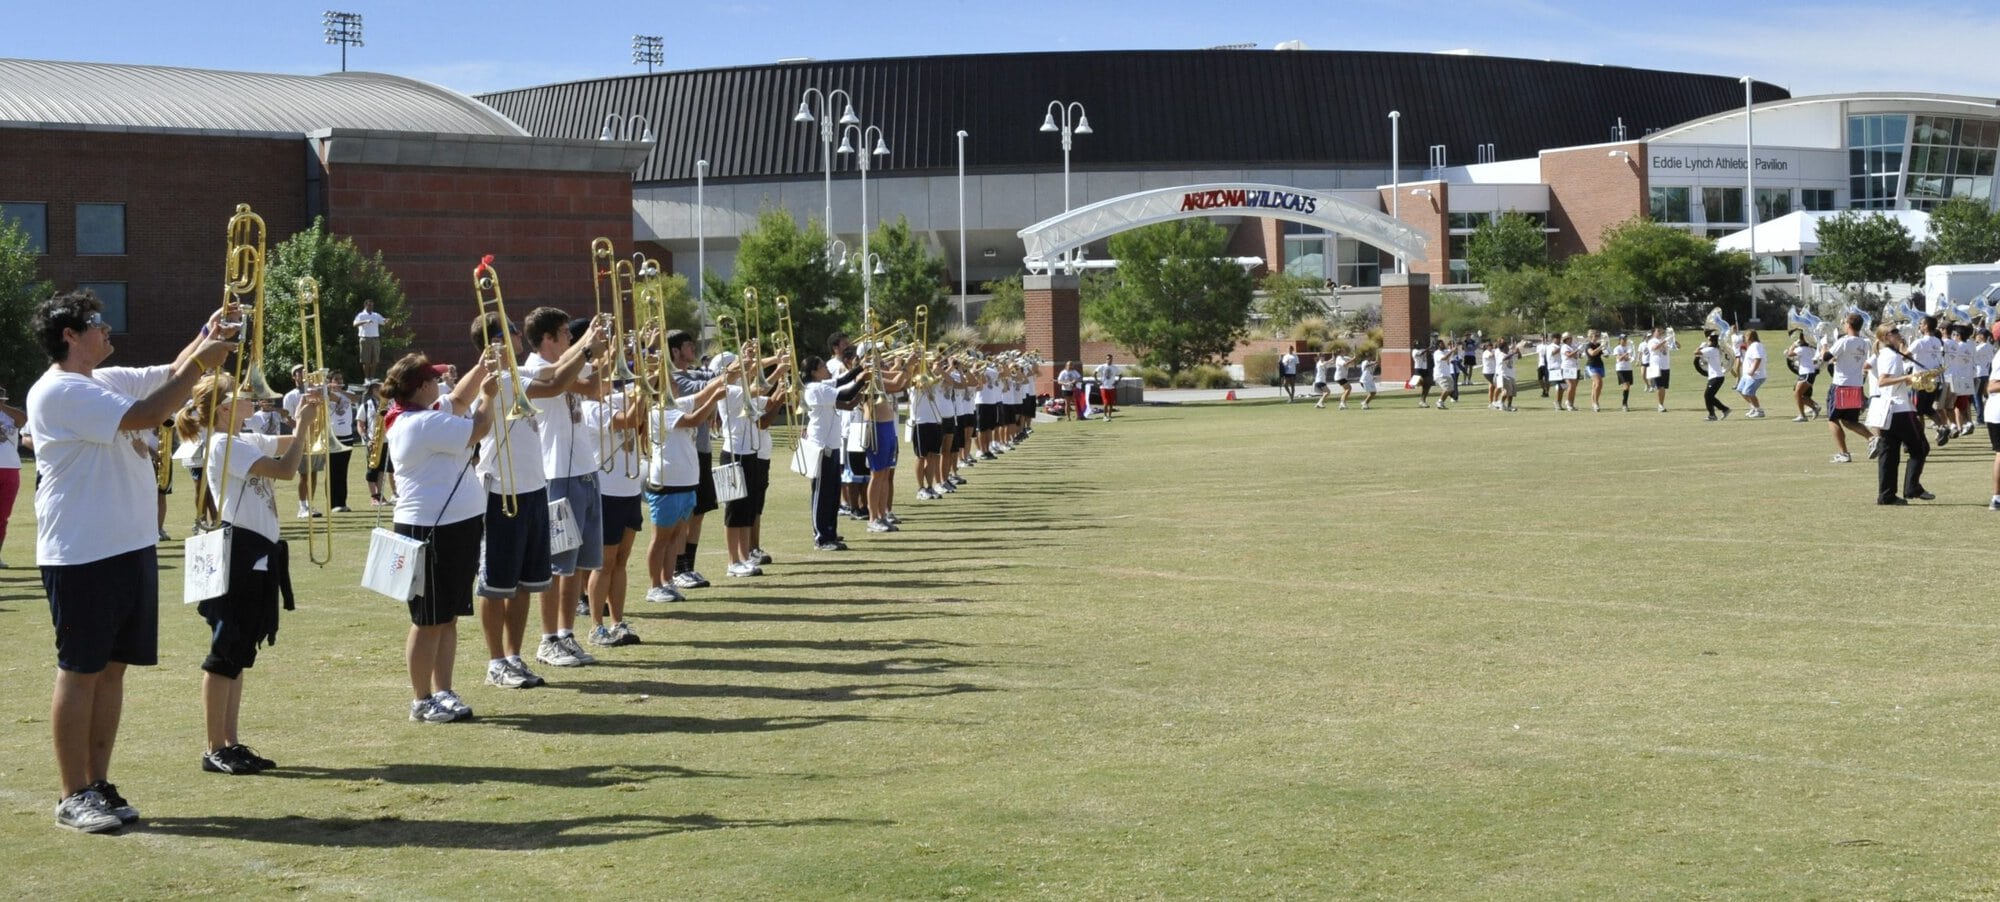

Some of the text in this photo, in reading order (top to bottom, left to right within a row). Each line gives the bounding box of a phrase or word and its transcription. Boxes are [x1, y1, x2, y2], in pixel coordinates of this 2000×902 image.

[1653, 156, 1682, 169] Eddie
[1685, 156, 1713, 171] Lynch
[1755, 158, 1787, 170] Pavilion
